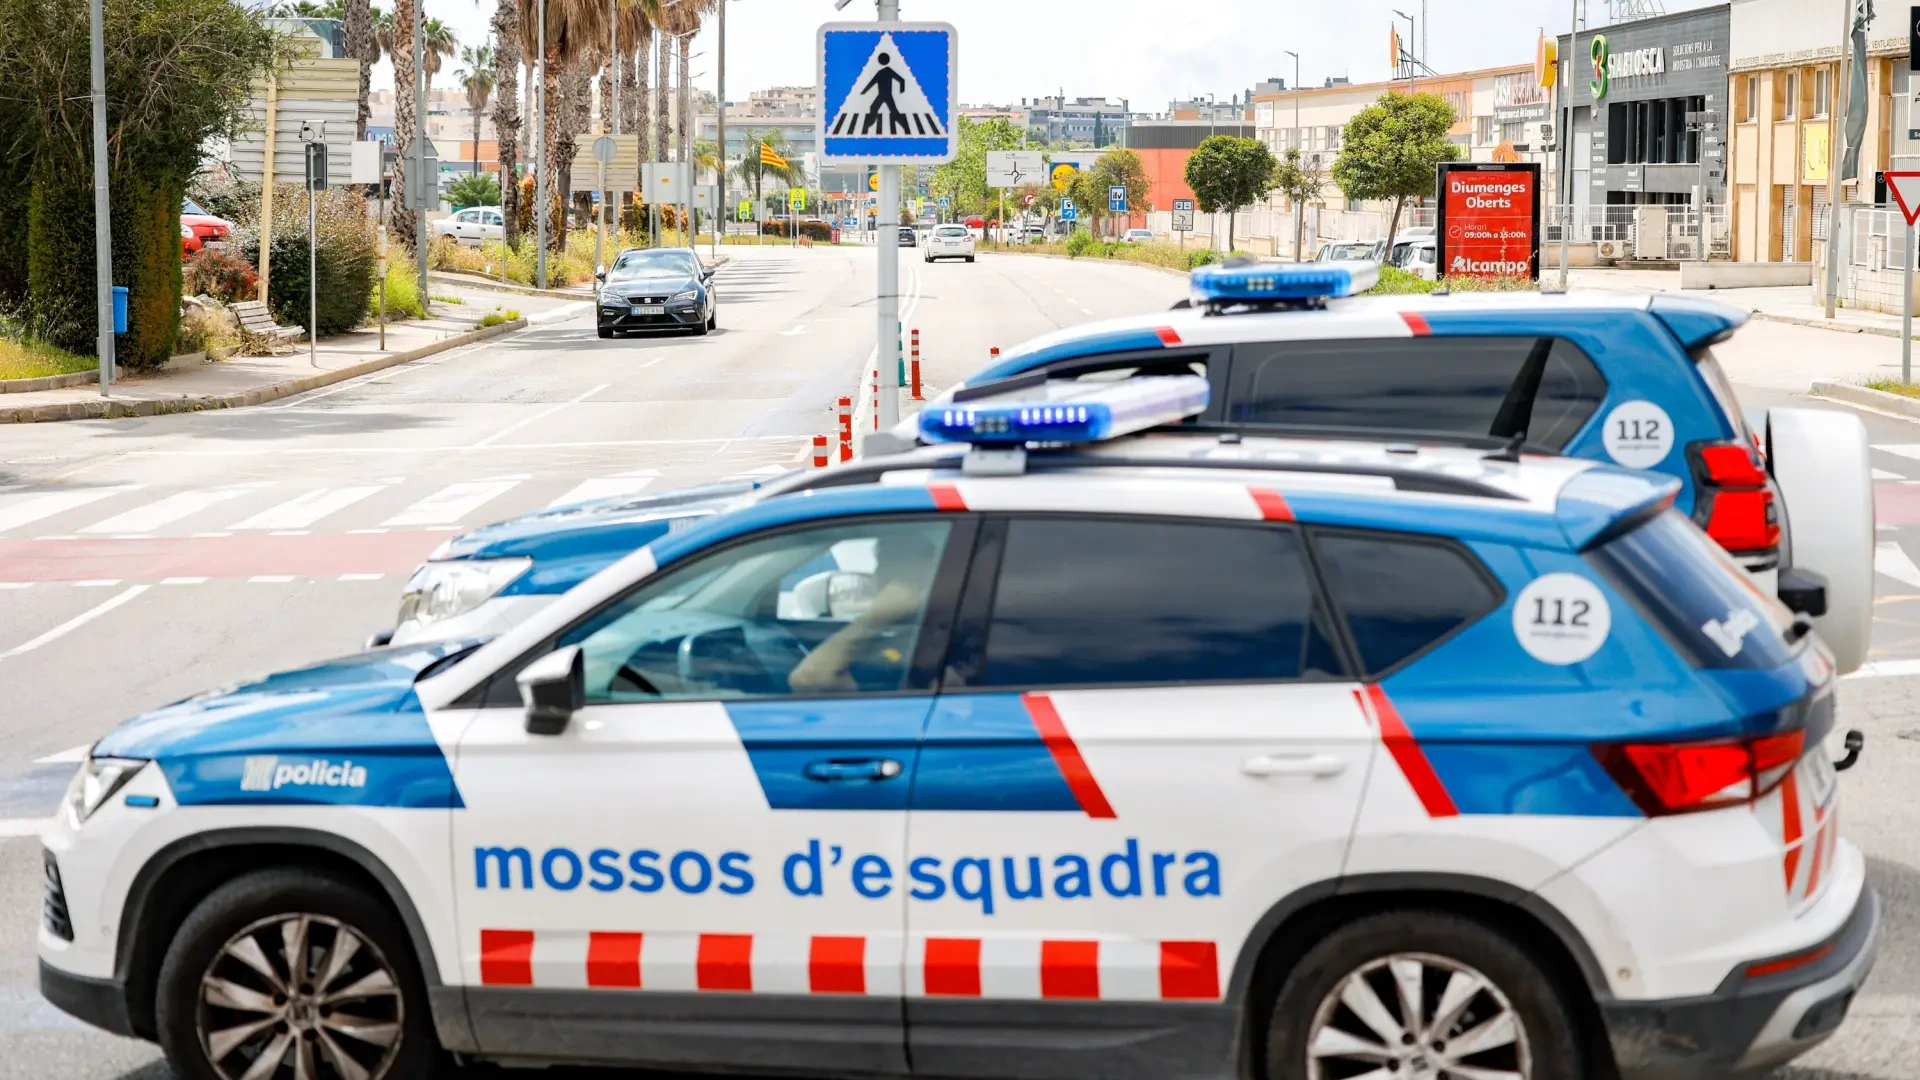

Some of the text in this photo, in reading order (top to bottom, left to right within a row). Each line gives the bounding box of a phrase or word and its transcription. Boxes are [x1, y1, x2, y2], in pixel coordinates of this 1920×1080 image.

[1451, 181, 1526, 196] Diumenges
[1465, 197, 1511, 209] Oberts
[1464, 223, 1487, 231] Horari
[1464, 231, 1493, 239] 09:00h
[1449, 255, 1528, 275] Alcampo
[1616, 418, 1660, 441] 112
[1530, 597, 1591, 628] 112
[273, 759, 368, 790] policia
[473, 844, 756, 896] mossos
